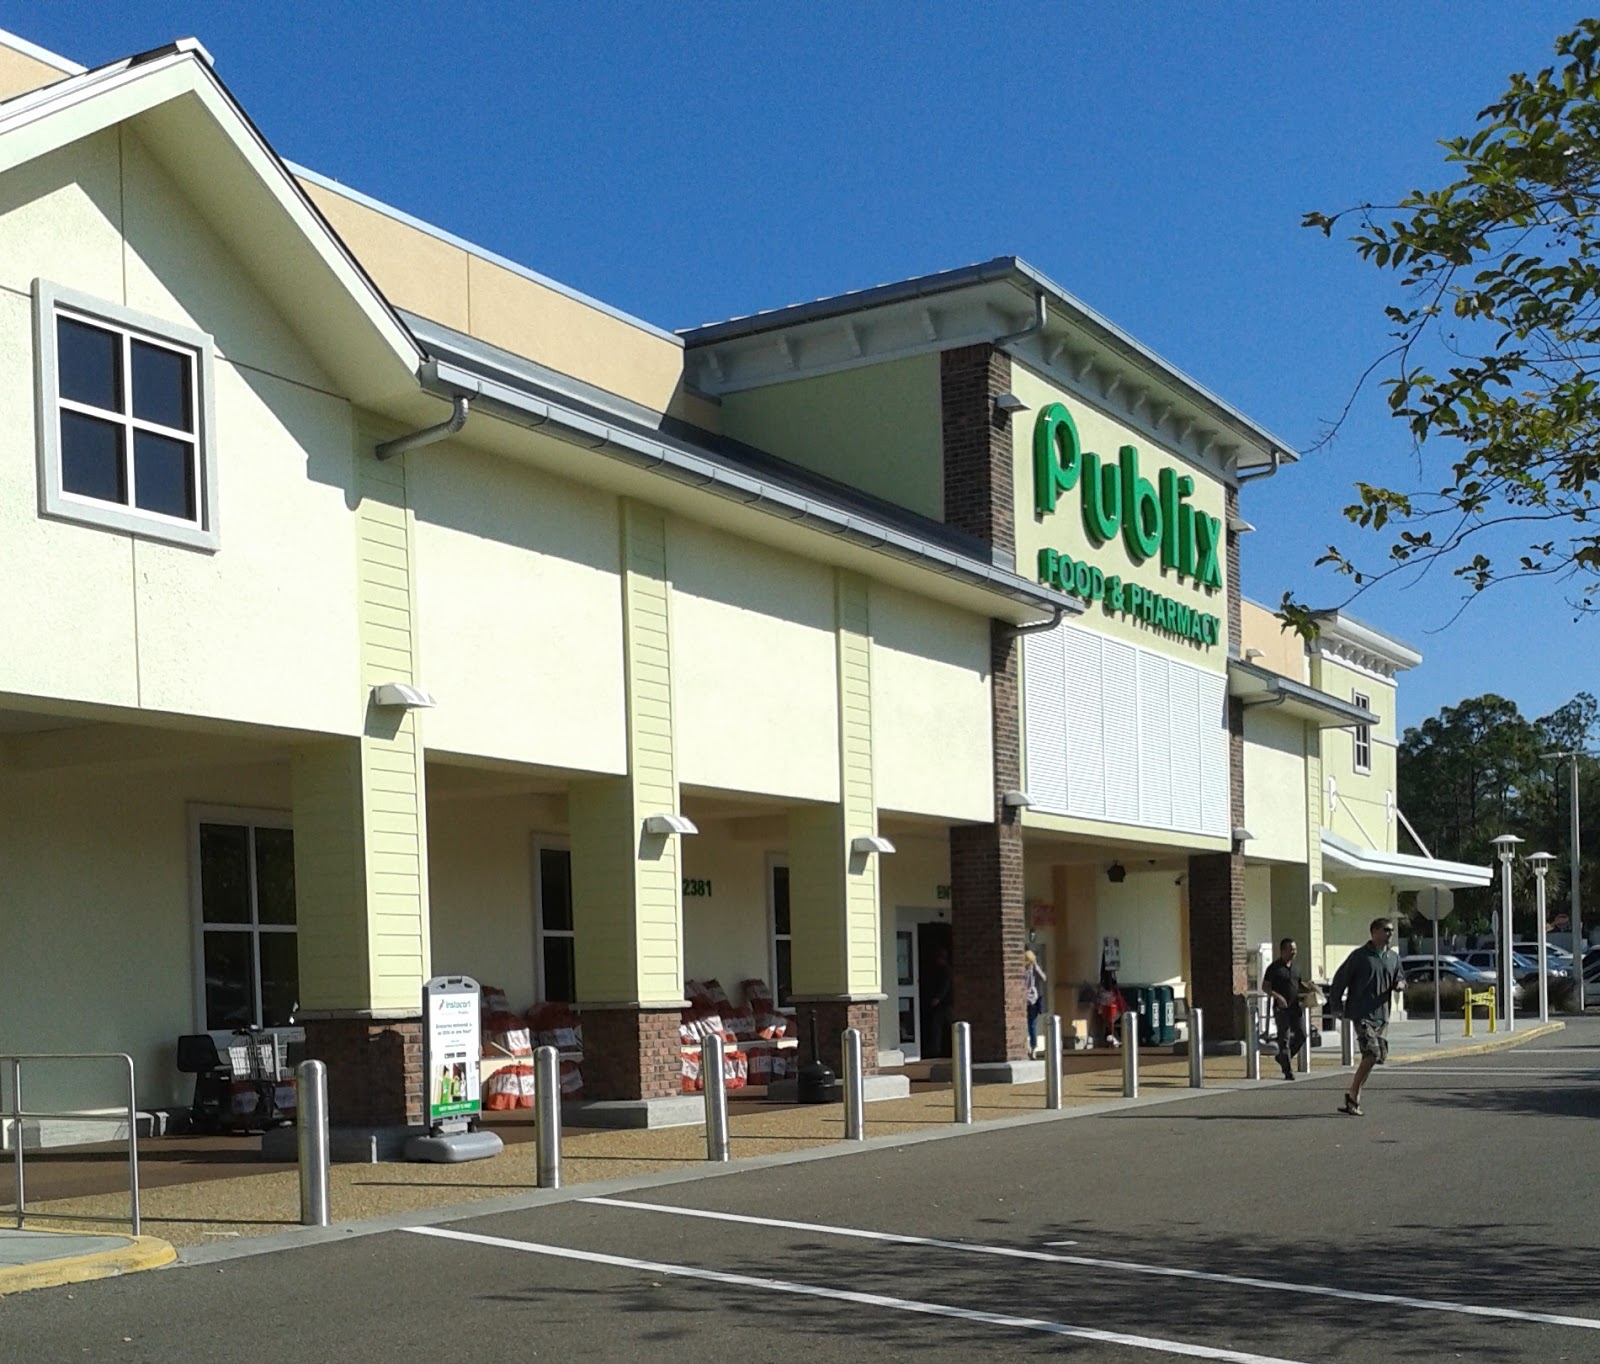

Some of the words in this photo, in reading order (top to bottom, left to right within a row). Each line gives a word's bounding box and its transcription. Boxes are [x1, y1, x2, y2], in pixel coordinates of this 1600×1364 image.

[1033, 402, 1222, 590] Publix
[1038, 547, 1105, 601] FOOD
[1105, 575, 1125, 611] &
[1122, 582, 1220, 646] PHARMACY
[682, 879, 712, 897] 2381
